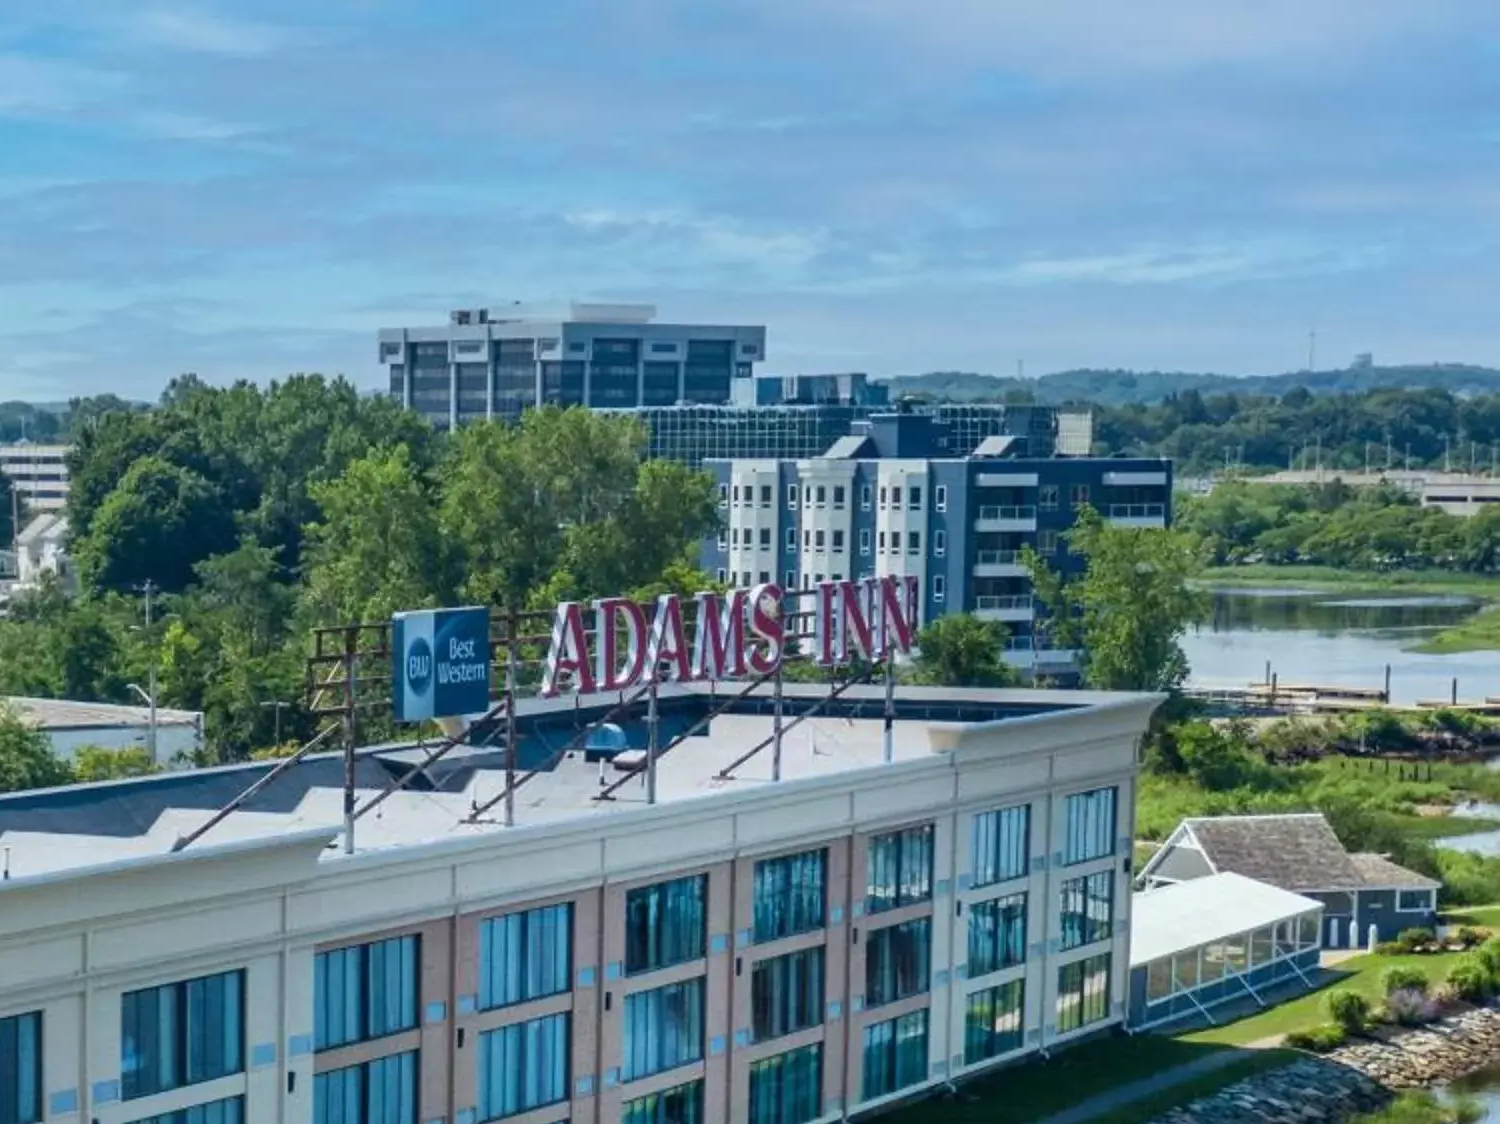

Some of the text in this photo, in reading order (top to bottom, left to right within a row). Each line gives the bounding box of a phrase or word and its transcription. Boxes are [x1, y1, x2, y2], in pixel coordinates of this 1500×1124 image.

[449, 636, 475, 660] Best
[541, 575, 918, 698] ADAMS INN
[409, 655, 430, 680] BW
[437, 662, 485, 684] Western
